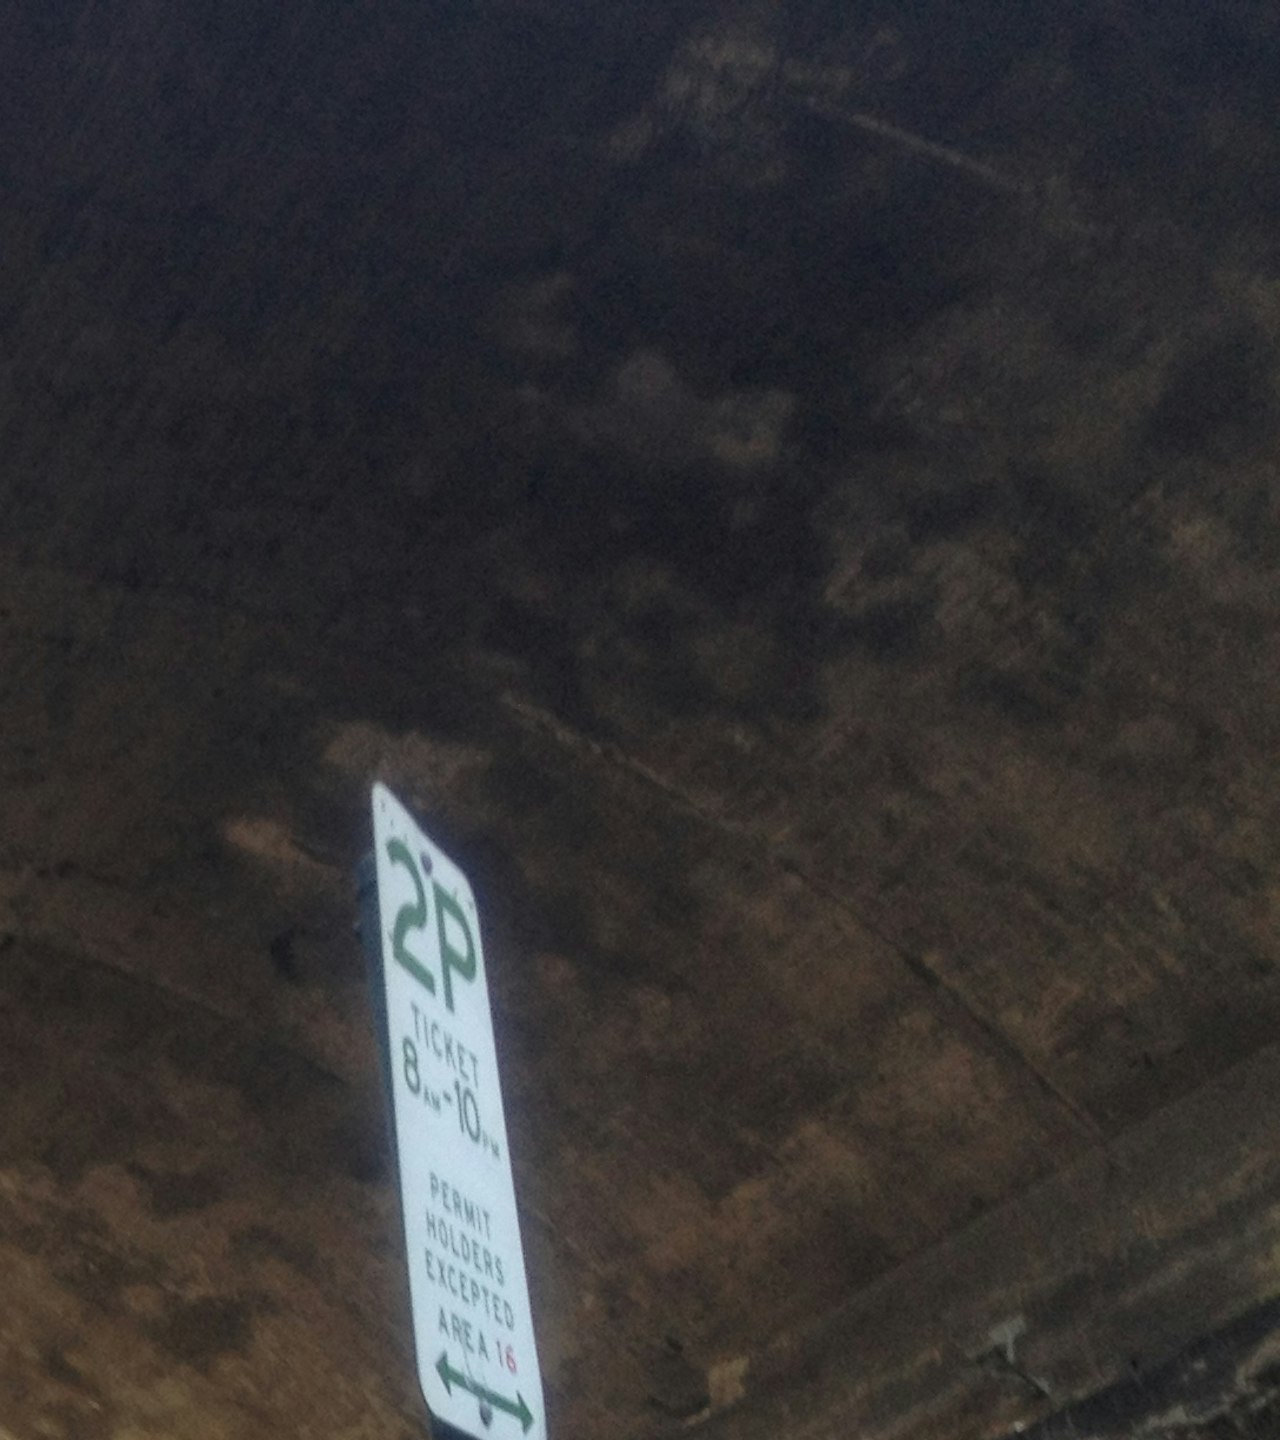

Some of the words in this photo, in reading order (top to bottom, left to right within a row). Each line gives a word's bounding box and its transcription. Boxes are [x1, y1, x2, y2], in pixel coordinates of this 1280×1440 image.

[386, 836, 476, 1014] 2P
[410, 1001, 479, 1089] TICKET
[429, 1171, 491, 1241] PERMIT
[426, 1207, 505, 1288] HOLDERS
[425, 1247, 515, 1331] EXCEPTED
[439, 1304, 489, 1362] AREA
